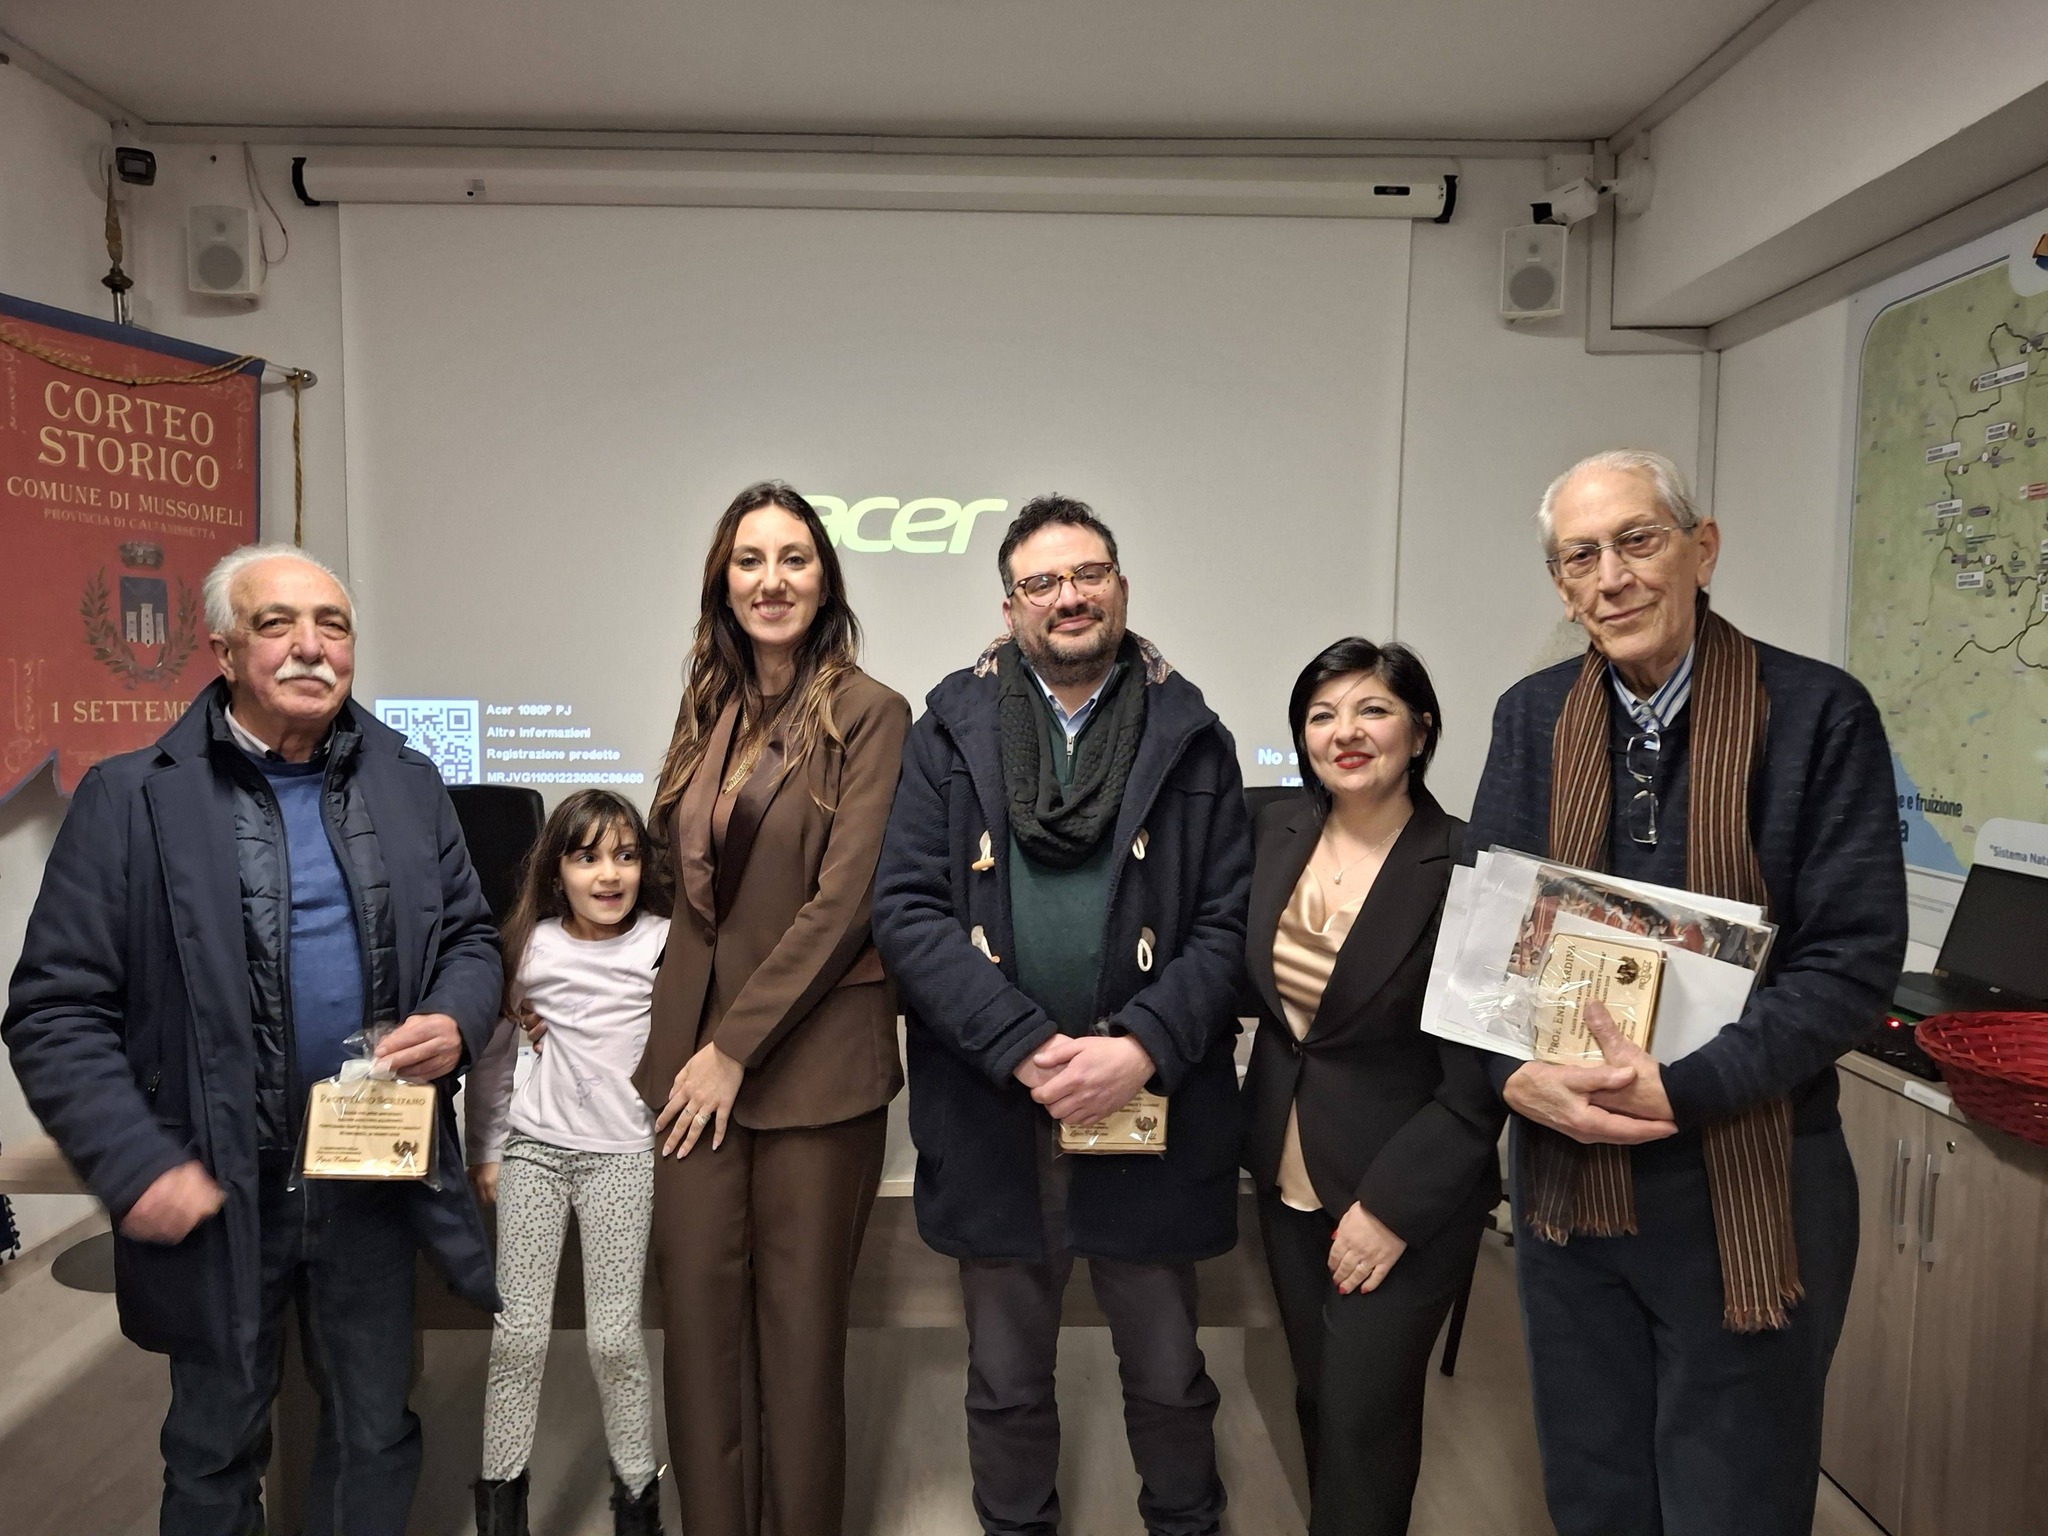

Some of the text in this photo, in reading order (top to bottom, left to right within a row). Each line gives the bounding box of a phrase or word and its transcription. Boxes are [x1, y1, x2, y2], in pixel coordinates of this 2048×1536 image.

[44, 380, 214, 446] CORTEO
[38, 425, 220, 490] STORICO
[6, 475, 243, 528] COMUNE DI MUSSOMELI
[43, 507, 111, 527] PROVINCIA
[113, 516, 126, 528] DI
[801, 494, 1009, 554] acer
[51, 701, 60, 723] 1
[486, 704, 572, 716] Acer 1080P PJ
[486, 726, 591, 738] Altre informazioni
[486, 748, 621, 762] Registrazione prodotto
[1258, 748, 1283, 765] No
[1915, 792, 1963, 818] fruizione
[1559, 944, 1576, 994] ARDINA
